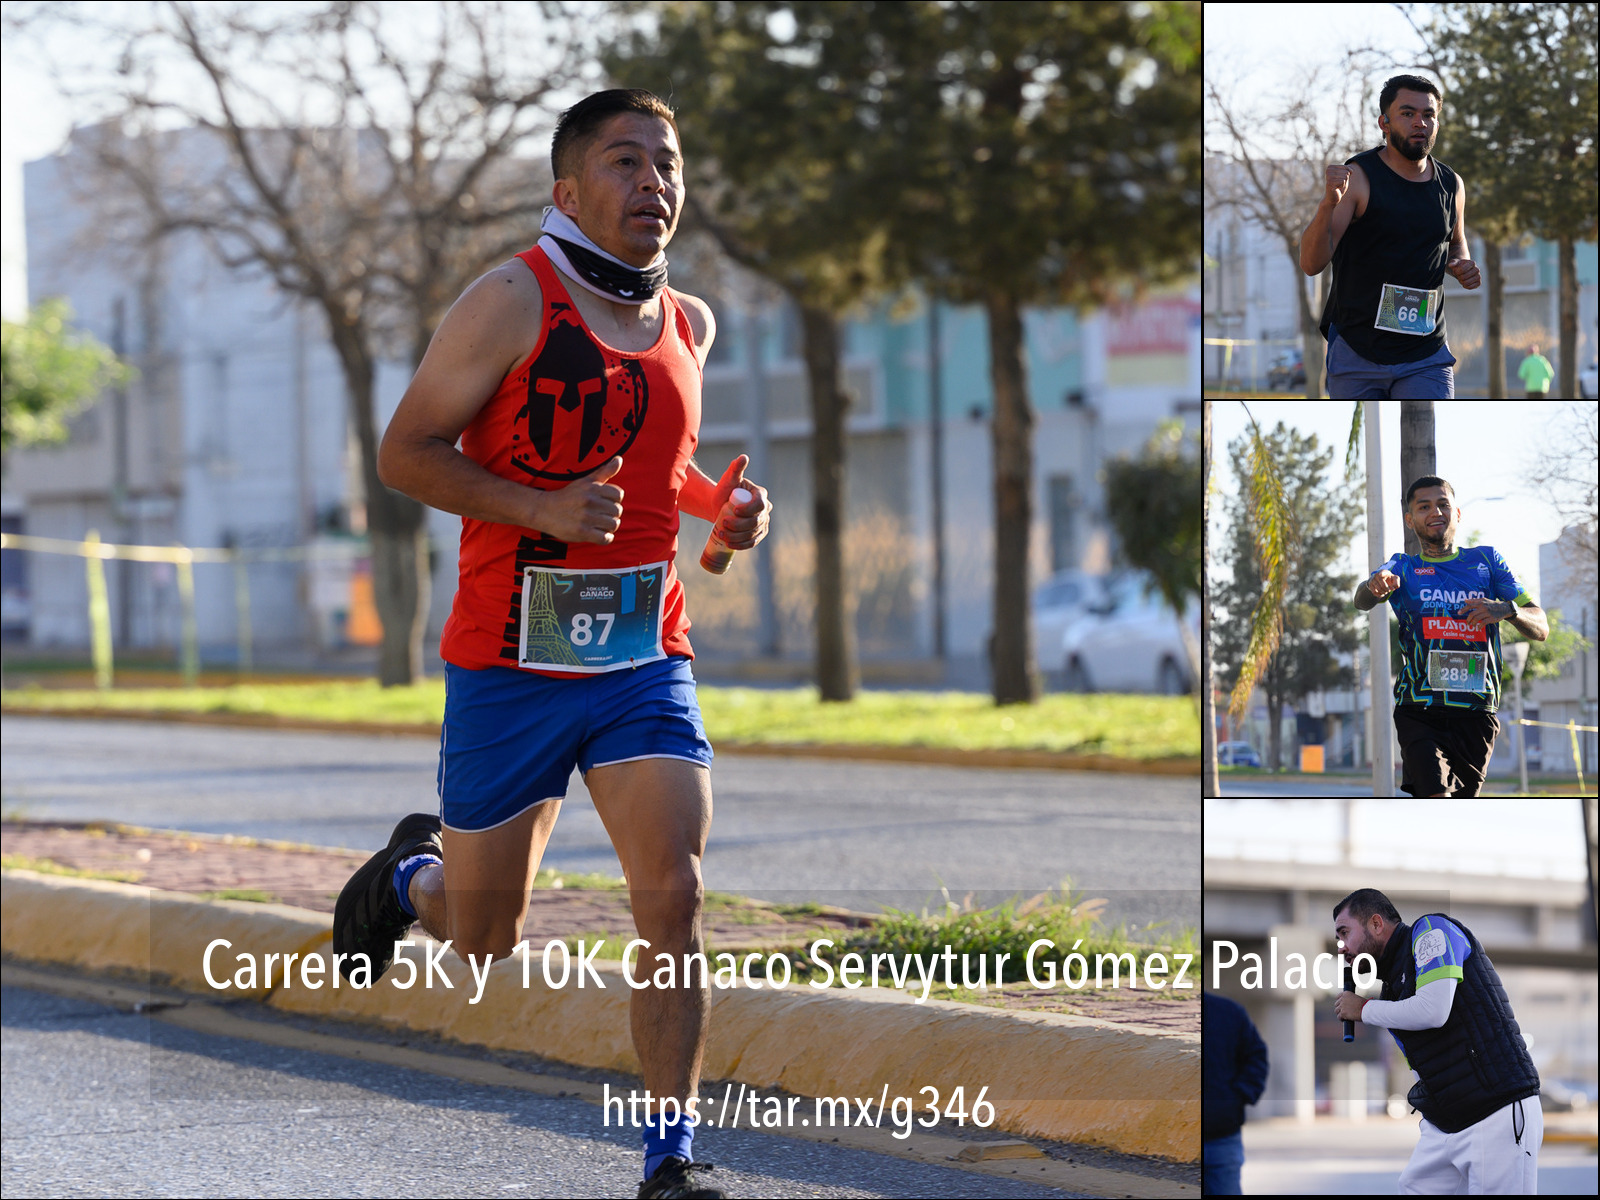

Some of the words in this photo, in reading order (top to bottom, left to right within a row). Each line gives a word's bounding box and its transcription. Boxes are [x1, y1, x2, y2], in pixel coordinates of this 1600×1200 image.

[1398, 306, 1418, 323] 66
[569, 612, 616, 647] 87
[1440, 667, 1468, 682] 288
